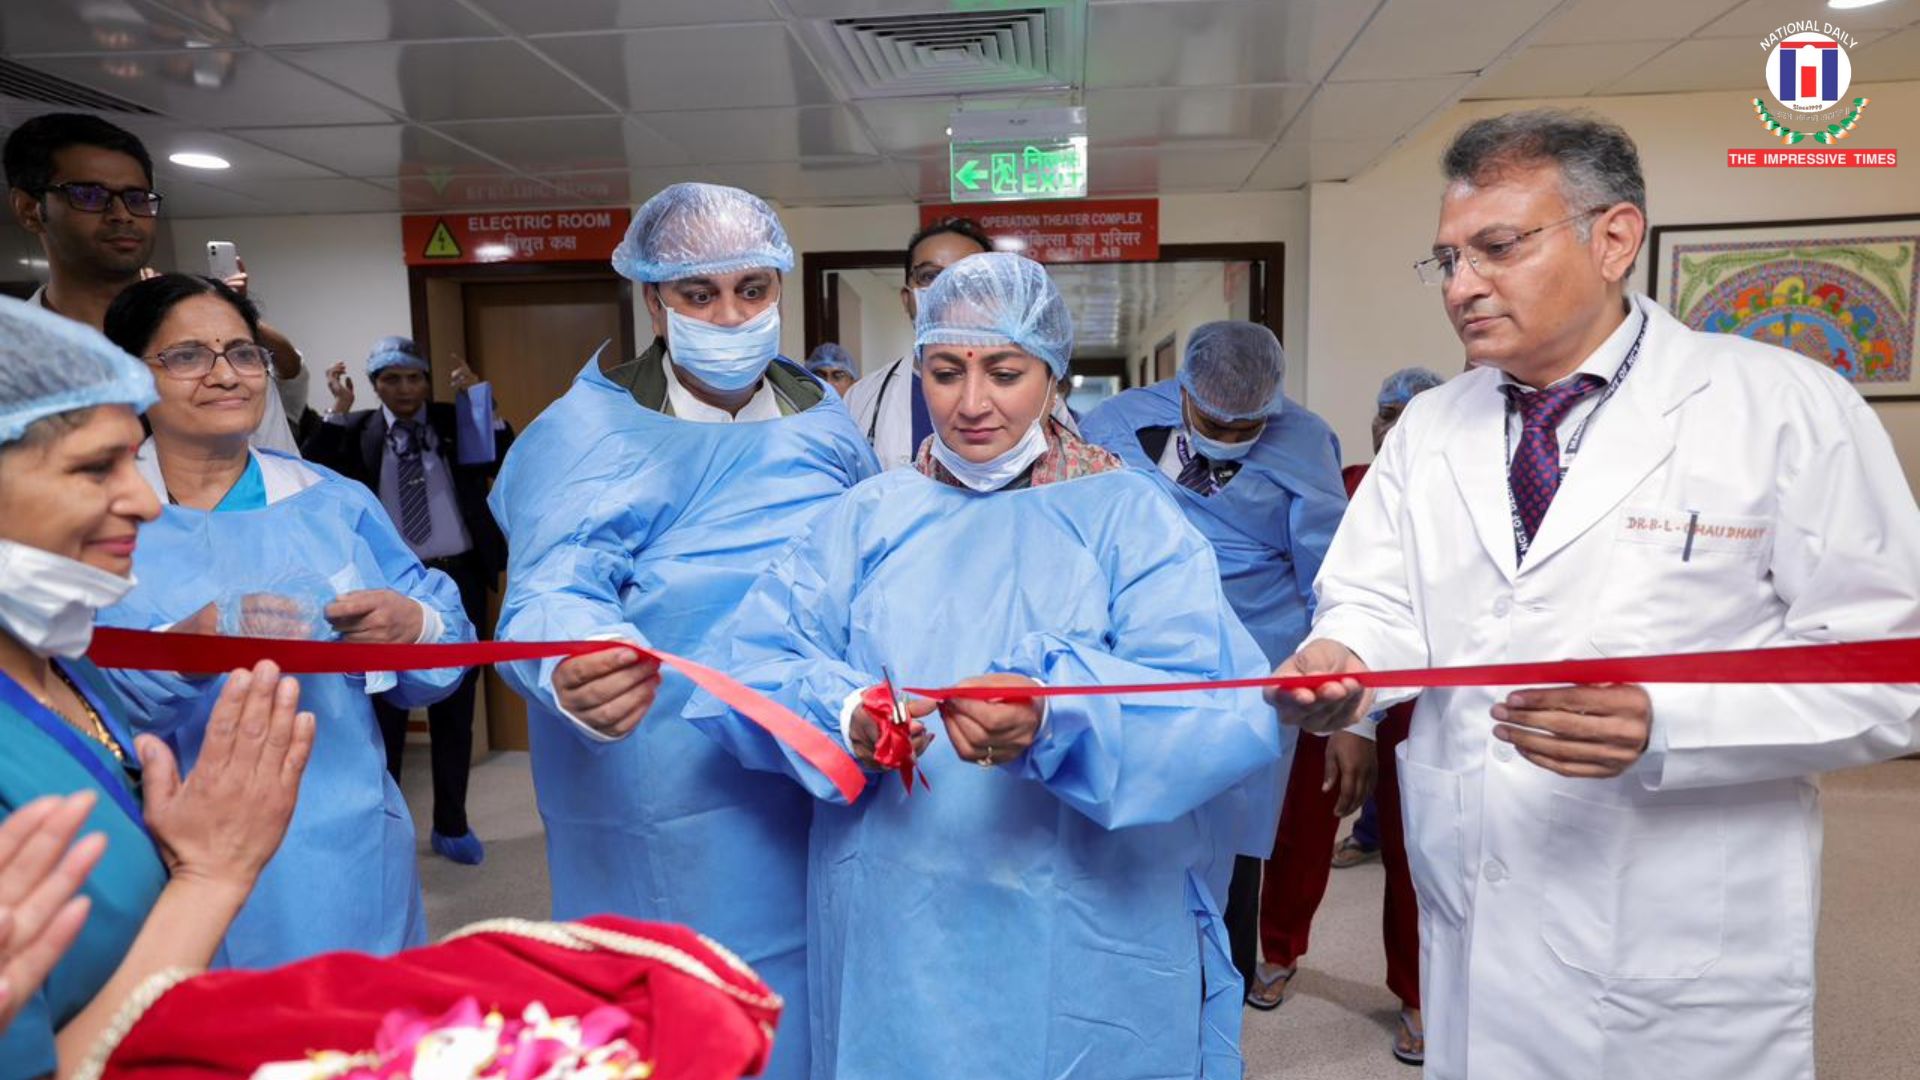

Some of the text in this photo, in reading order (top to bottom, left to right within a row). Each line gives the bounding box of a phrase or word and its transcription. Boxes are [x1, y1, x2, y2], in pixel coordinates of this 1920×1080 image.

[1022, 172, 1083, 193] EXIT
[468, 213, 611, 231] ELECTRIC ROOM
[980, 212, 1142, 228] OPERATION THEATER COMPLEX
[549, 234, 576, 250] कक्ष
[1072, 231, 1096, 247] कक्ष
[1100, 227, 1141, 247] परिसर
[1091, 247, 1121, 258] LAB
